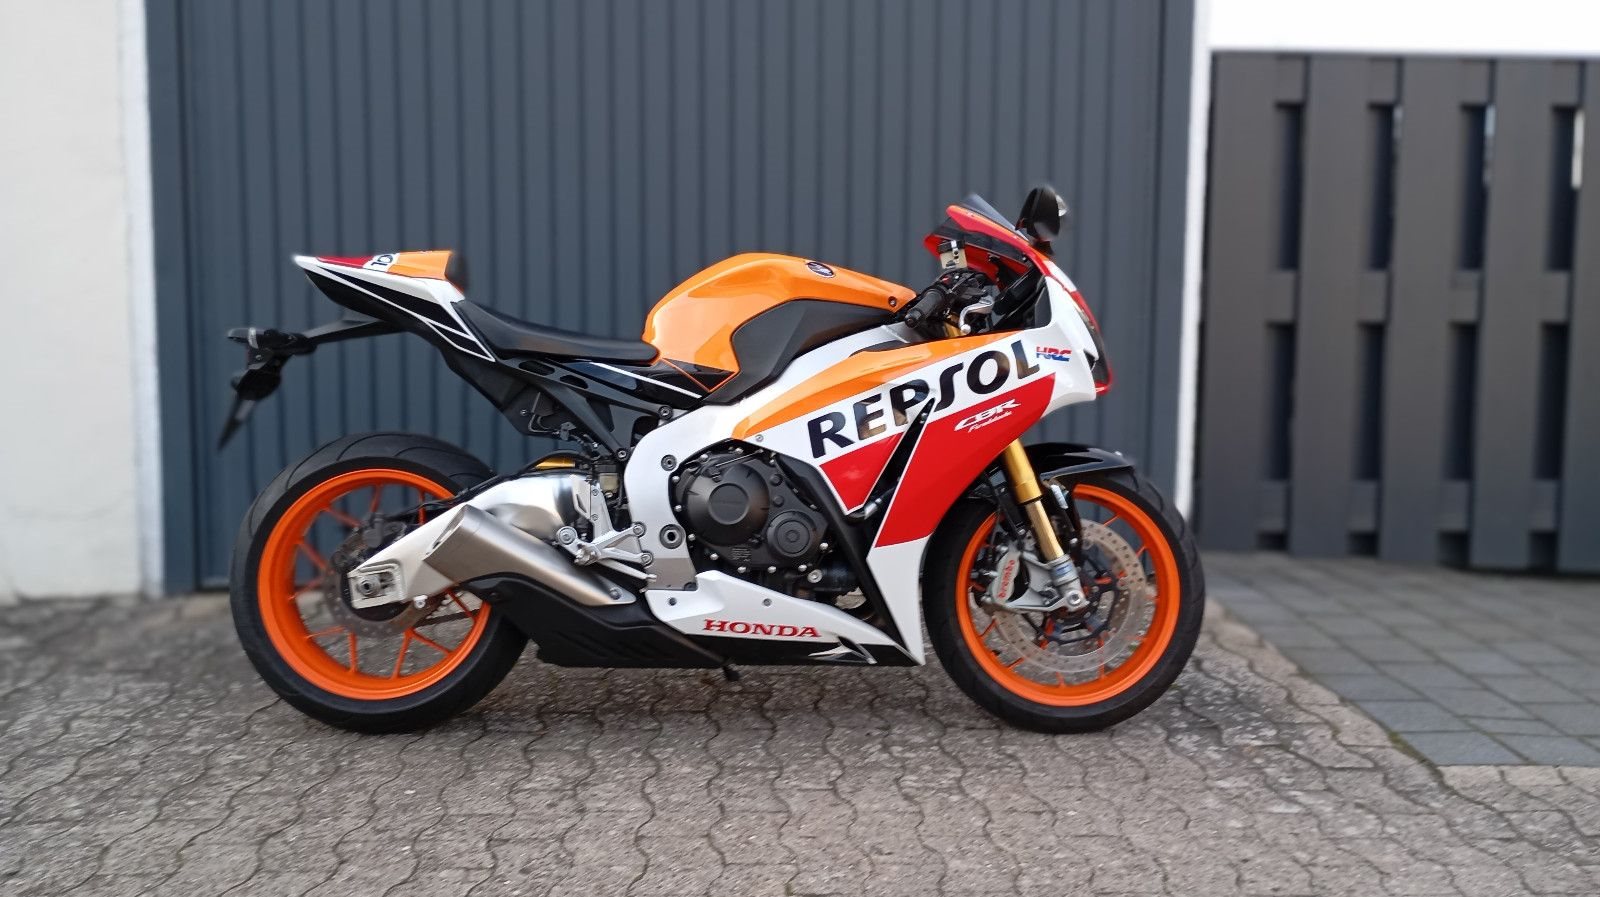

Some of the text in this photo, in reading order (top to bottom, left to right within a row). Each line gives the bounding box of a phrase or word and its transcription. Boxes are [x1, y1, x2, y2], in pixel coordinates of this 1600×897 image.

[1036, 346, 1072, 362] HRC
[807, 340, 1040, 458] REPSOL
[954, 399, 1021, 431] CBR
[702, 619, 822, 637] HONDA
